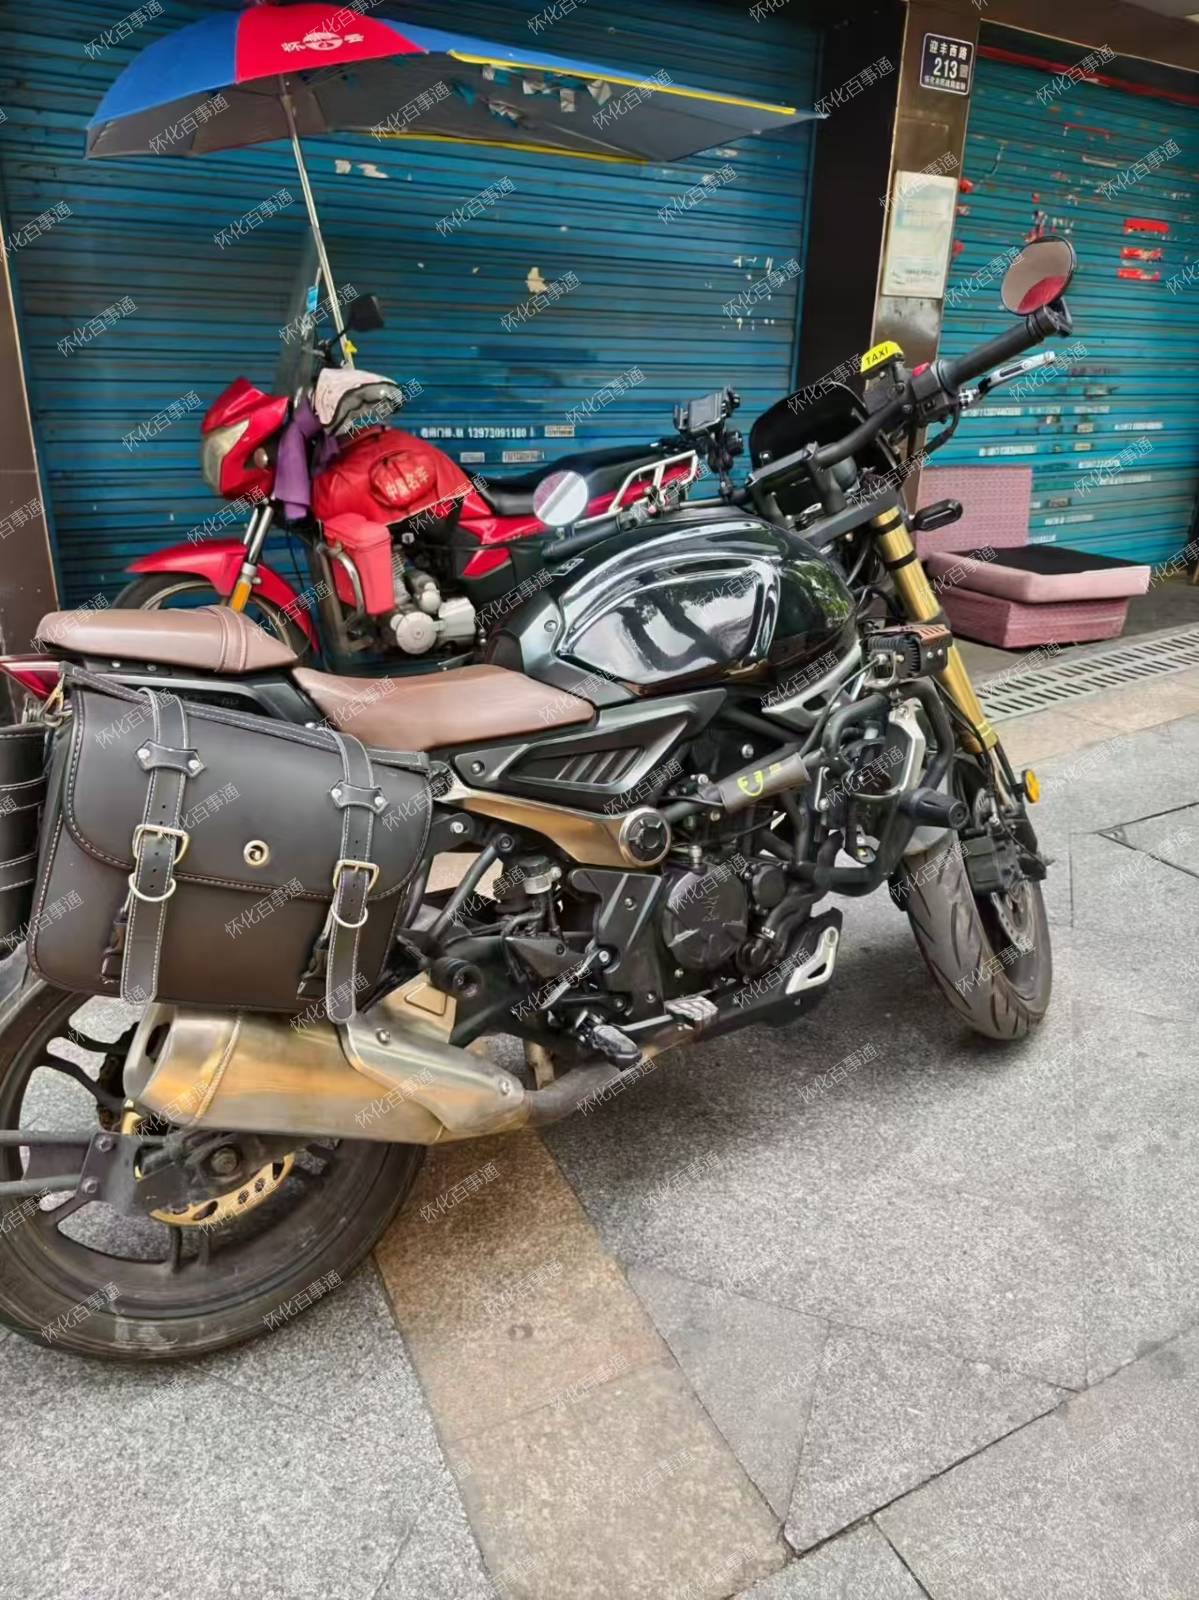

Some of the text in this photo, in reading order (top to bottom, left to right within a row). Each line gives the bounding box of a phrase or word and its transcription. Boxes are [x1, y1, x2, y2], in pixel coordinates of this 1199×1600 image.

[929, 40, 967, 60] 迎丰西路
[933, 57, 958, 79] 213
[866, 345, 889, 365] TAXI
